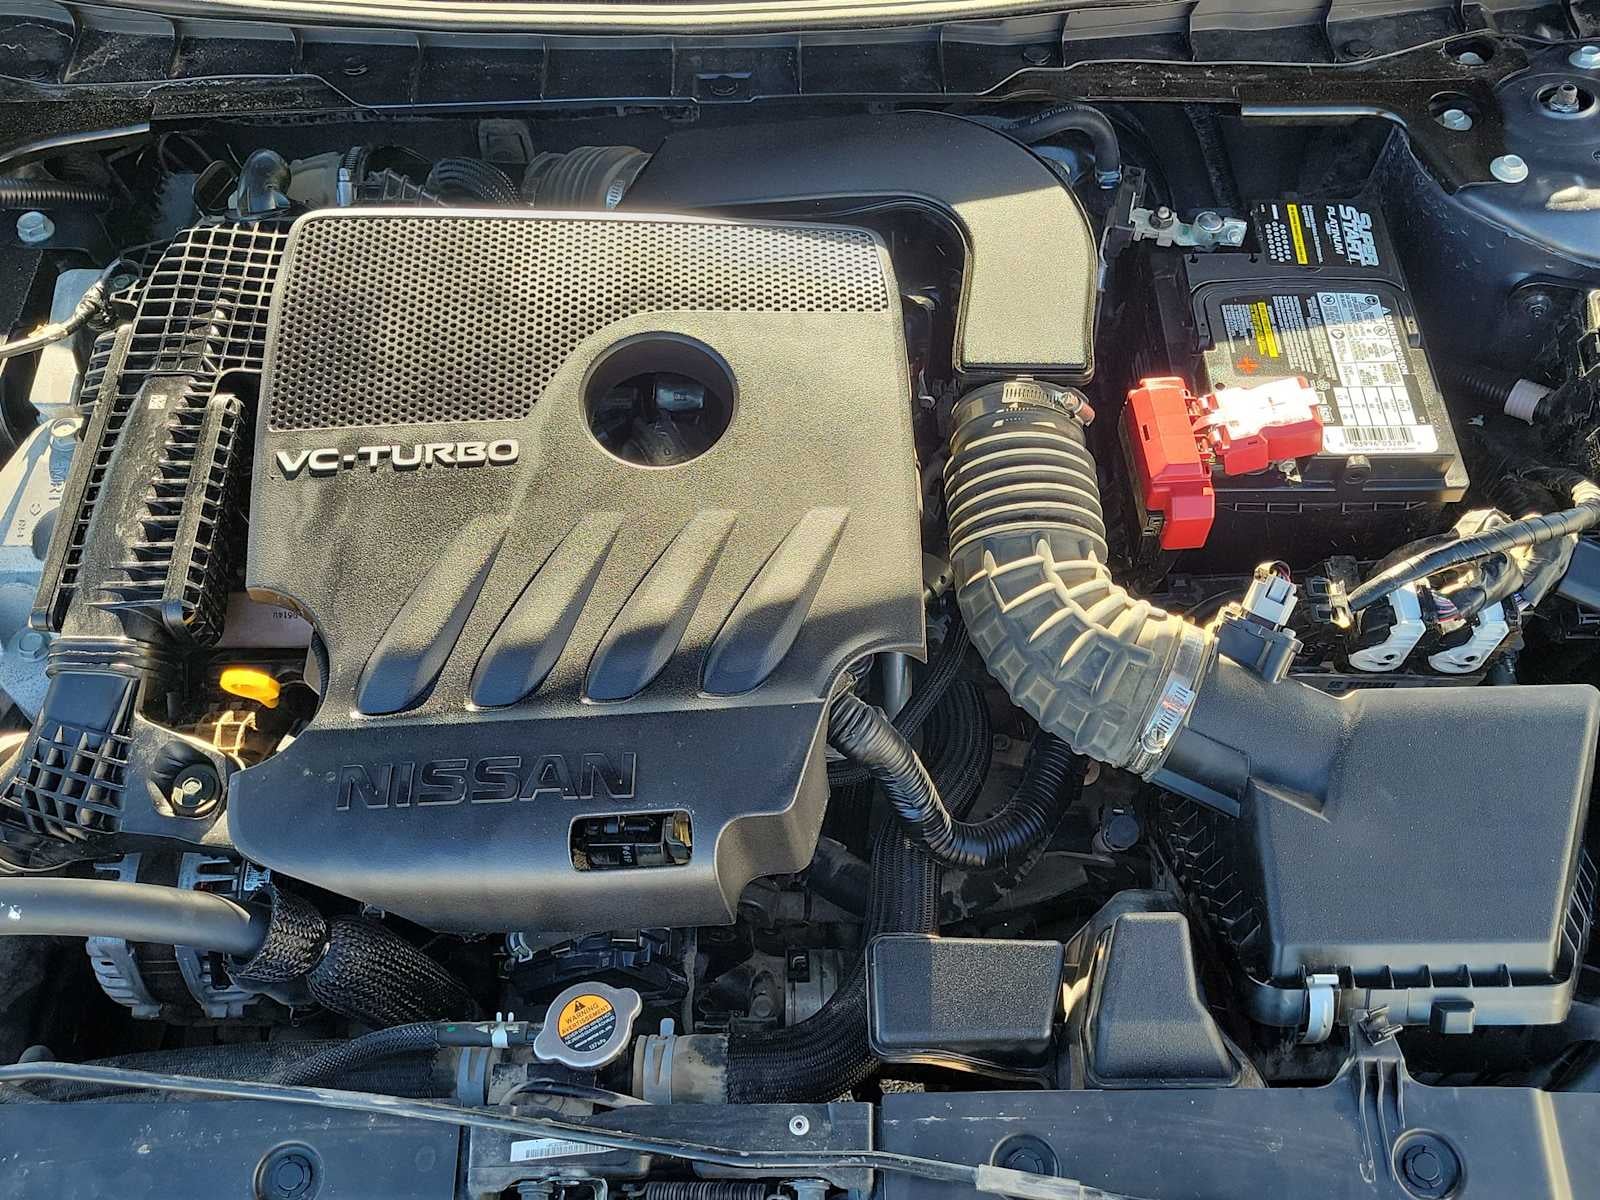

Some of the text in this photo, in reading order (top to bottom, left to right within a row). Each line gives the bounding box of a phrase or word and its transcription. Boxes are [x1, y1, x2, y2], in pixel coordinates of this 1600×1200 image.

[1325, 204, 1345, 255] PLATINUM
[1339, 204, 1367, 267] START
[1355, 212, 1379, 267] SUPER
[276, 439, 519, 477] VC-TURBO
[336, 752, 637, 811] NISSAN
[561, 1004, 610, 1035] AVERTISSEMENT
[566, 1001, 599, 1024] WARNING
